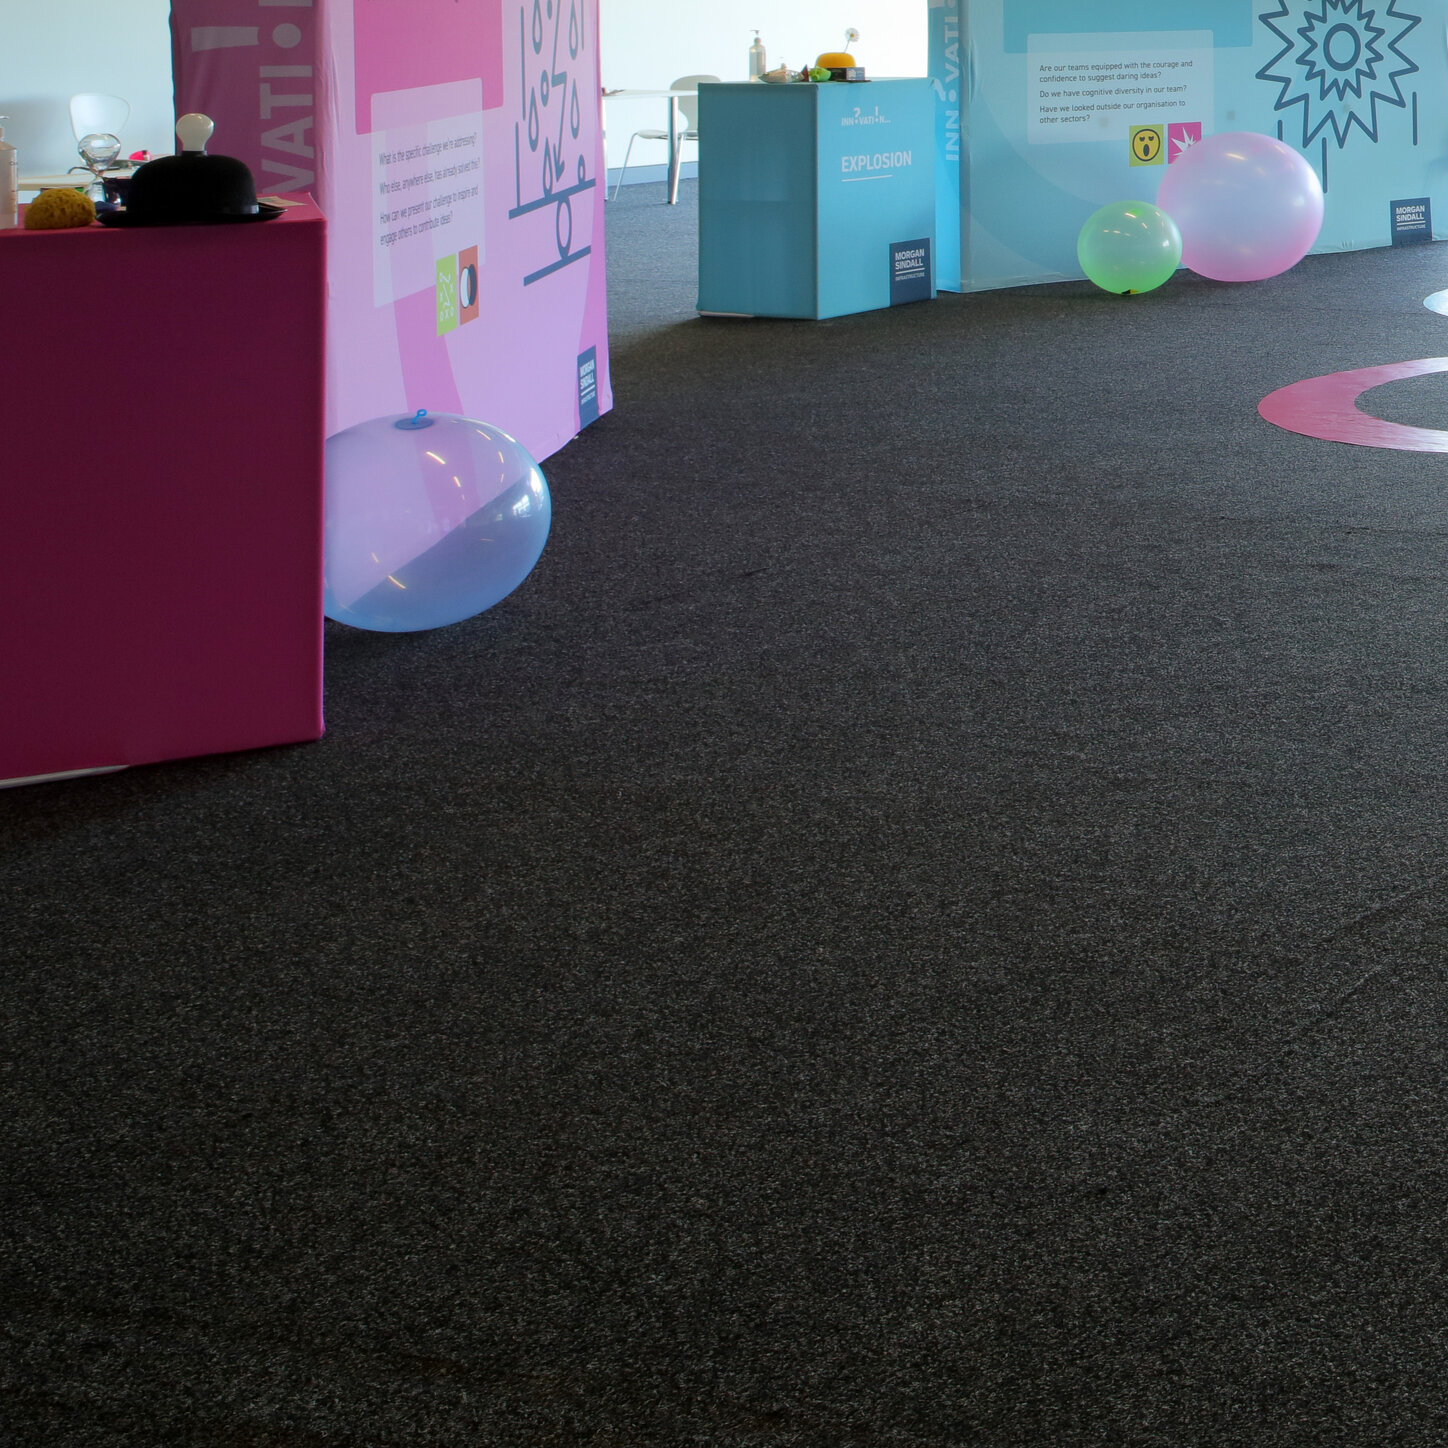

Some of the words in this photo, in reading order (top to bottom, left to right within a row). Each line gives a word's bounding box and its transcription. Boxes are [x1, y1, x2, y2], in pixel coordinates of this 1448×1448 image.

[1091, 63, 1122, 71] equipped
[1040, 75, 1077, 83] confidence
[1088, 74, 1115, 82] suggest
[1116, 73, 1138, 81] daring
[1140, 71, 1161, 79] ideas?
[1063, 89, 1080, 97] have
[1082, 89, 1113, 97] cognitive
[1115, 87, 1144, 96] diversity
[1040, 105, 1057, 113] Have
[1097, 103, 1121, 111] outside
[1136, 100, 1177, 110] organisation
[1040, 116, 1058, 124] other
[1061, 115, 1090, 123] sectors?
[841, 151, 912, 172] EXPLOSION
[1396, 205, 1425, 214] MORGAN
[1396, 213, 1424, 221] SINDALL
[895, 249, 925, 261] MORGAN
[895, 260, 923, 270] SINDALL
